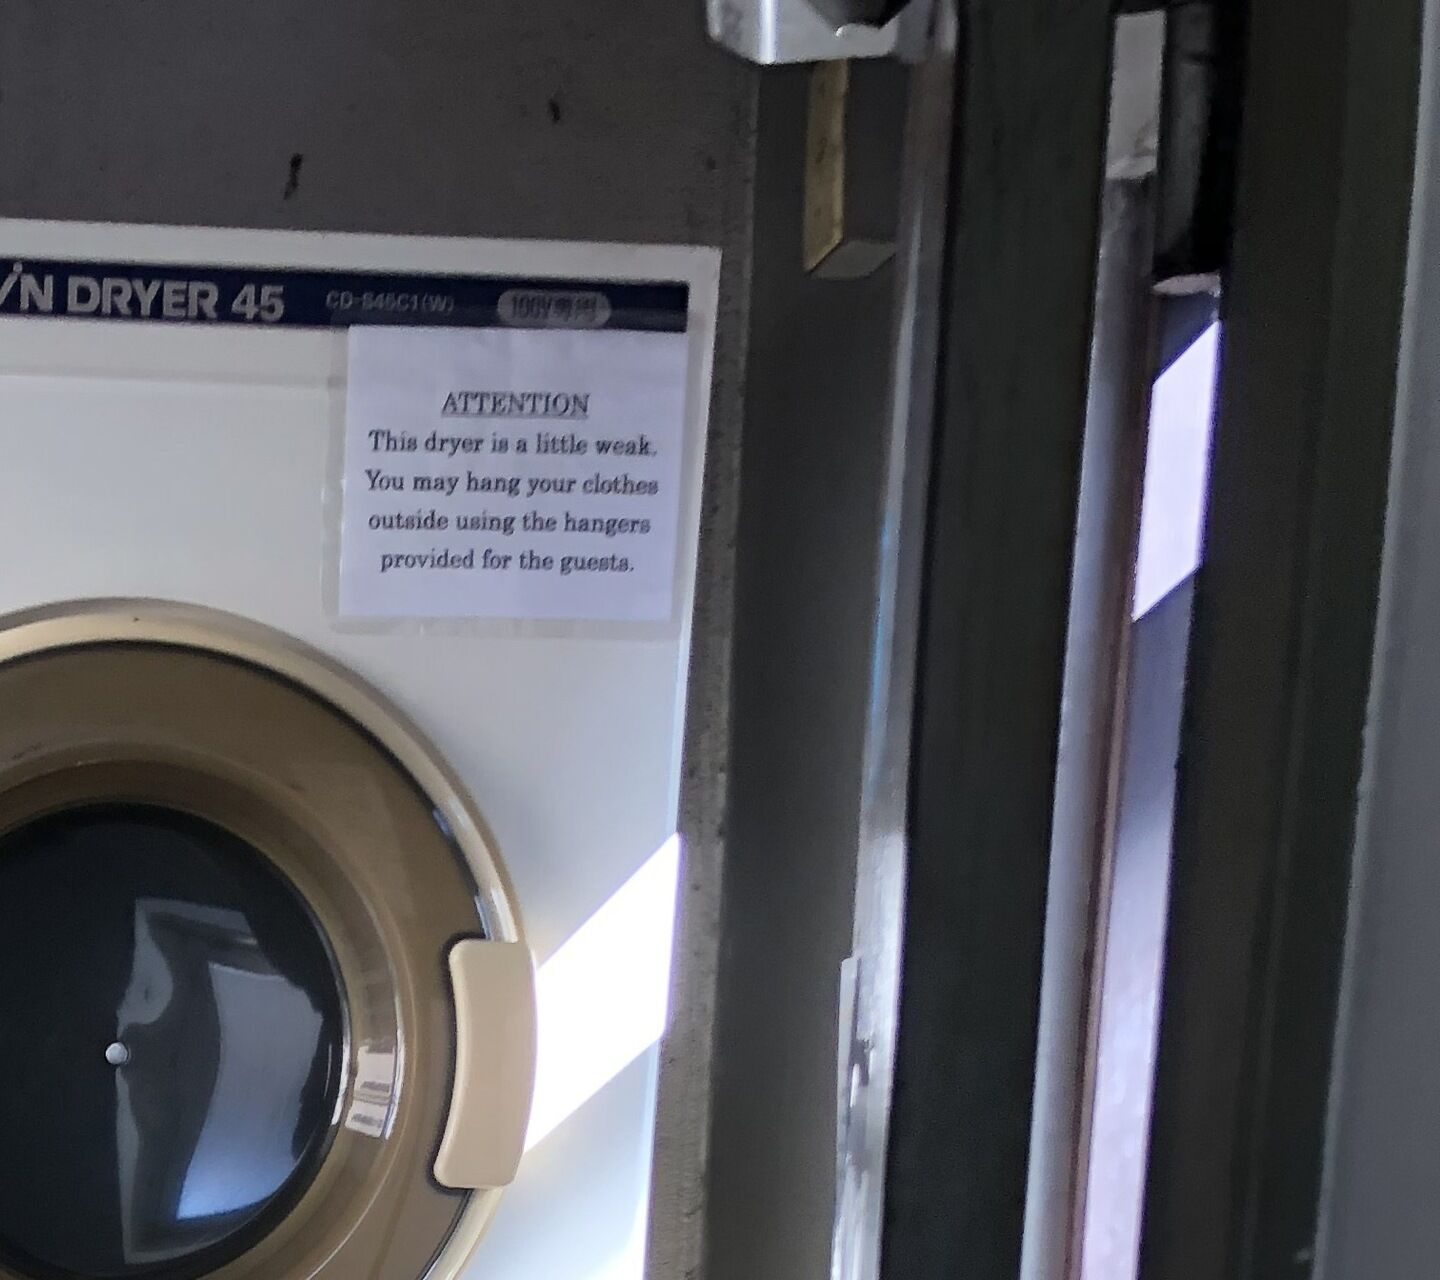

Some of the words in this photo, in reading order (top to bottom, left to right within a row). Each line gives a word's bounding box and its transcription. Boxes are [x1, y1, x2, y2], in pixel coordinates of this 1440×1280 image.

[67, 274, 220, 318] DRYER
[231, 283, 285, 321] 45
[441, 391, 591, 418] ATTENTION
[368, 429, 417, 452] This
[425, 431, 483, 457] dryer
[491, 433, 509, 454] is
[516, 439, 527, 453] a
[536, 432, 587, 455] little
[595, 434, 657, 457] weak.
[365, 469, 404, 491] You
[412, 477, 459, 496] may
[467, 471, 521, 497] hang
[526, 478, 576, 498] your
[582, 473, 659, 495] clothes
[368, 510, 448, 531] outside
[456, 510, 515, 536] using
[522, 511, 557, 532] the
[563, 511, 652, 537] hangers
[380, 548, 474, 573] provided
[482, 549, 512, 570] for
[519, 549, 553, 571] the
[560, 553, 634, 576] guests.
